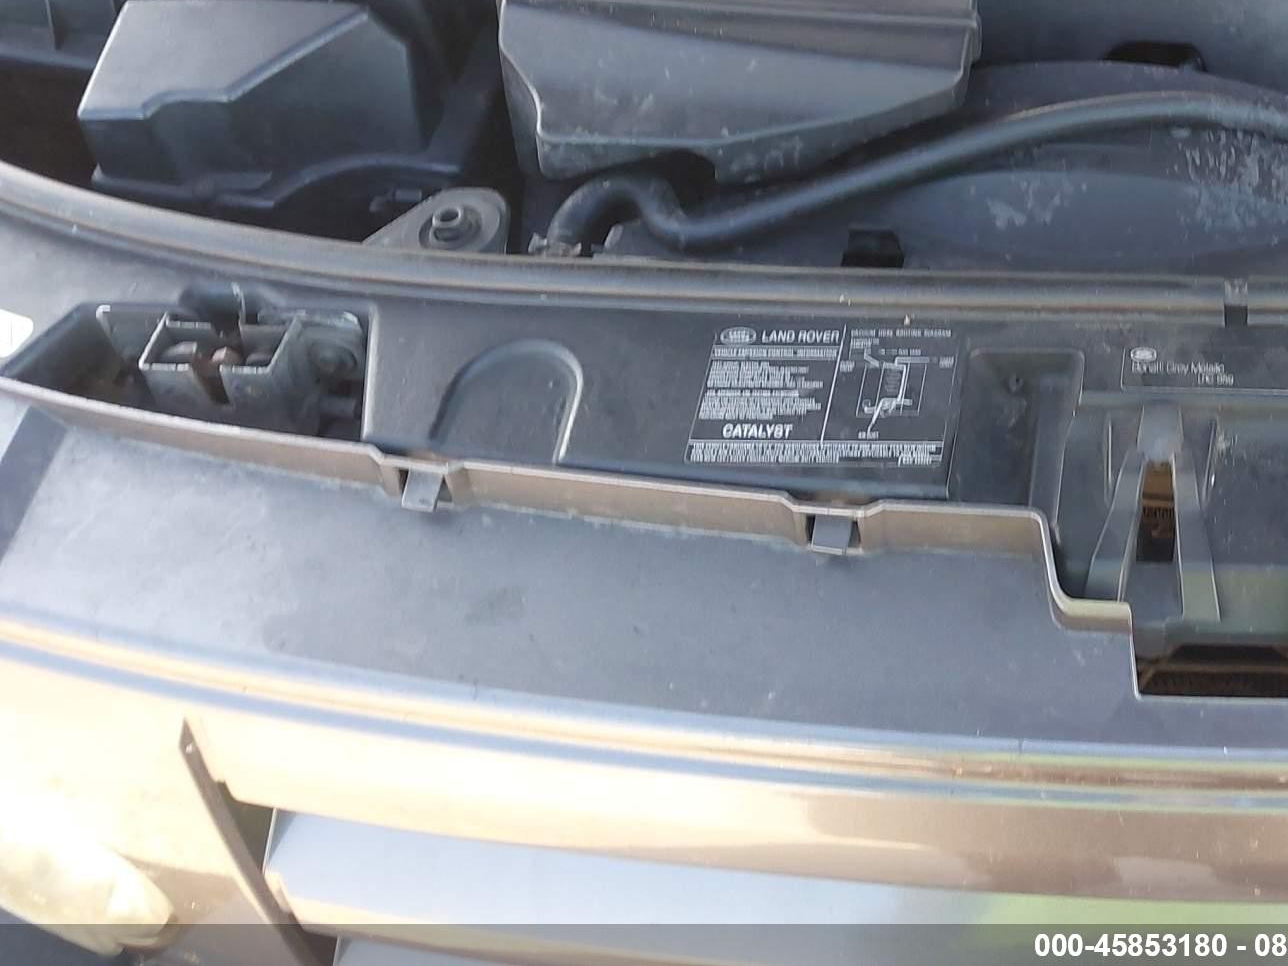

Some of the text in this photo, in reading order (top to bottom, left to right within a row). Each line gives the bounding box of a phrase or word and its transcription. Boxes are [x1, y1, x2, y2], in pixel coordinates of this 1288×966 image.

[761, 329, 796, 344] LAND
[797, 329, 841, 344] ROVER
[722, 422, 794, 439] CATALYST
